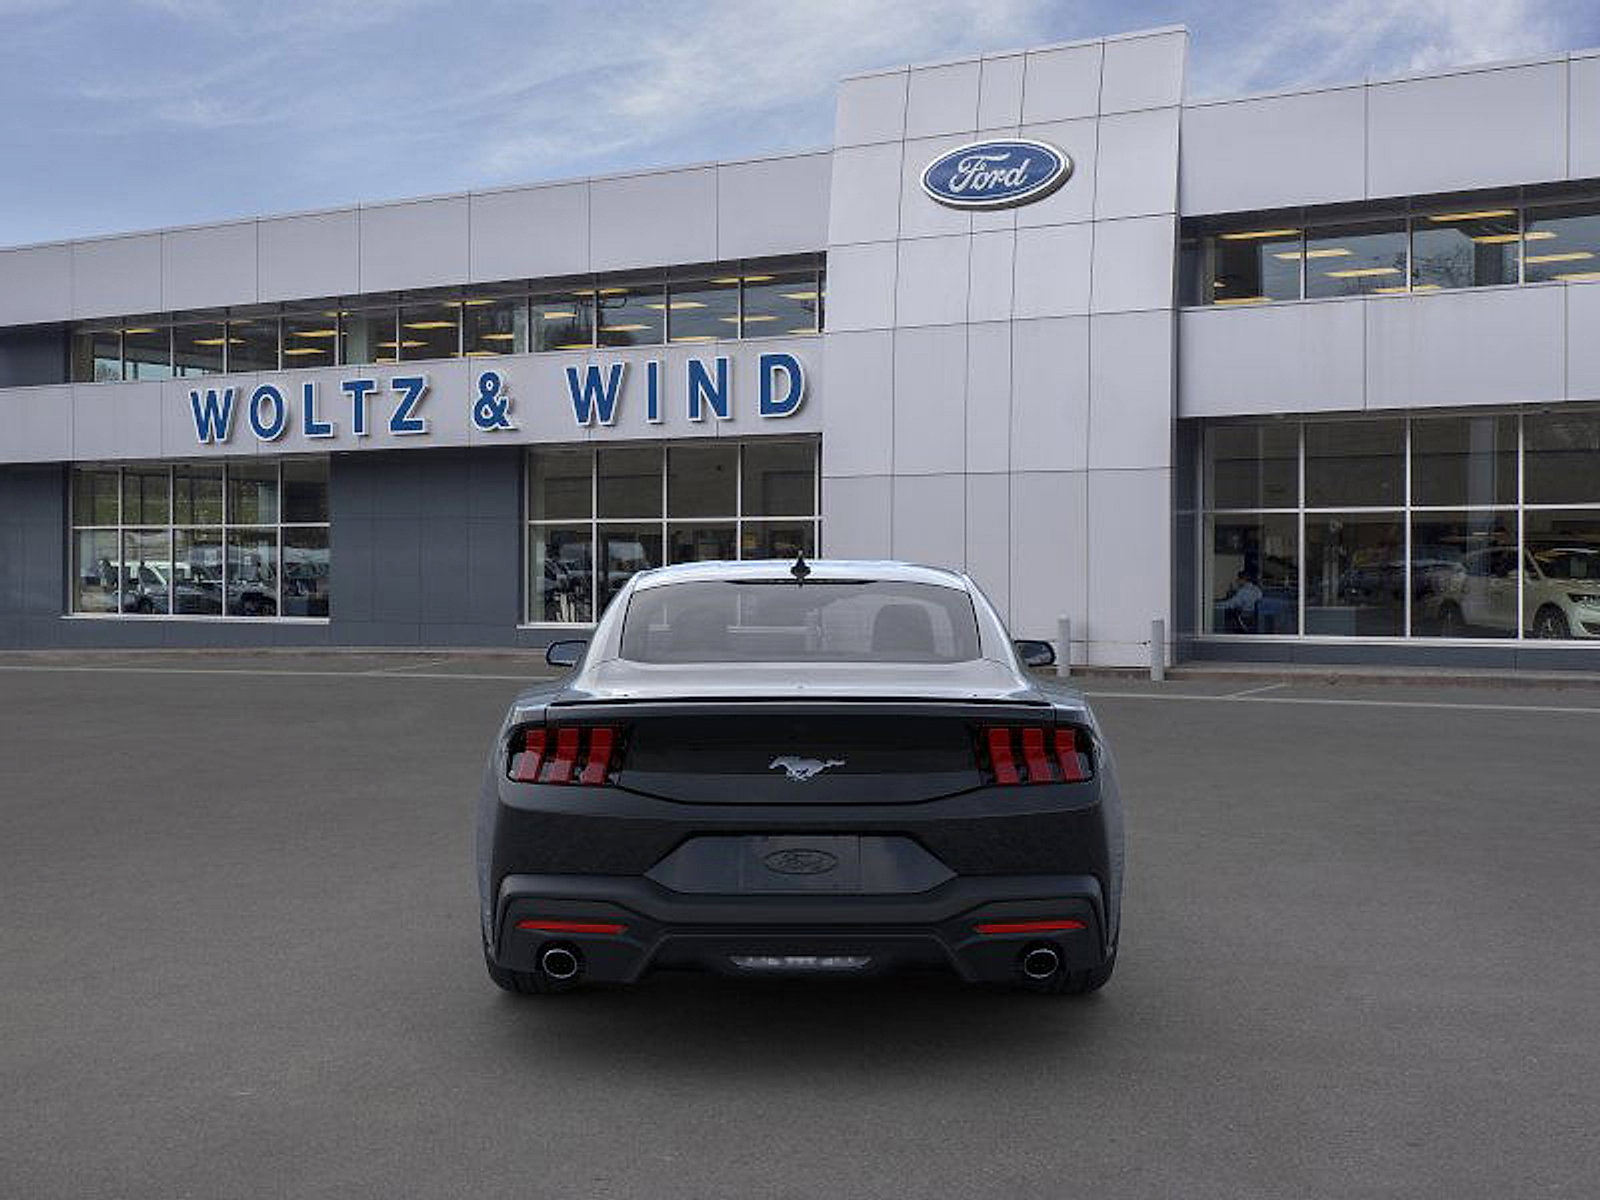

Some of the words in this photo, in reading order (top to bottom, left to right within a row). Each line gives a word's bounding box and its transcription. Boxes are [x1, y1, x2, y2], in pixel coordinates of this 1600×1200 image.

[949, 151, 1030, 194] Ford
[190, 374, 430, 443] WOLTZ
[473, 369, 516, 430] &
[567, 352, 807, 427] WIND
